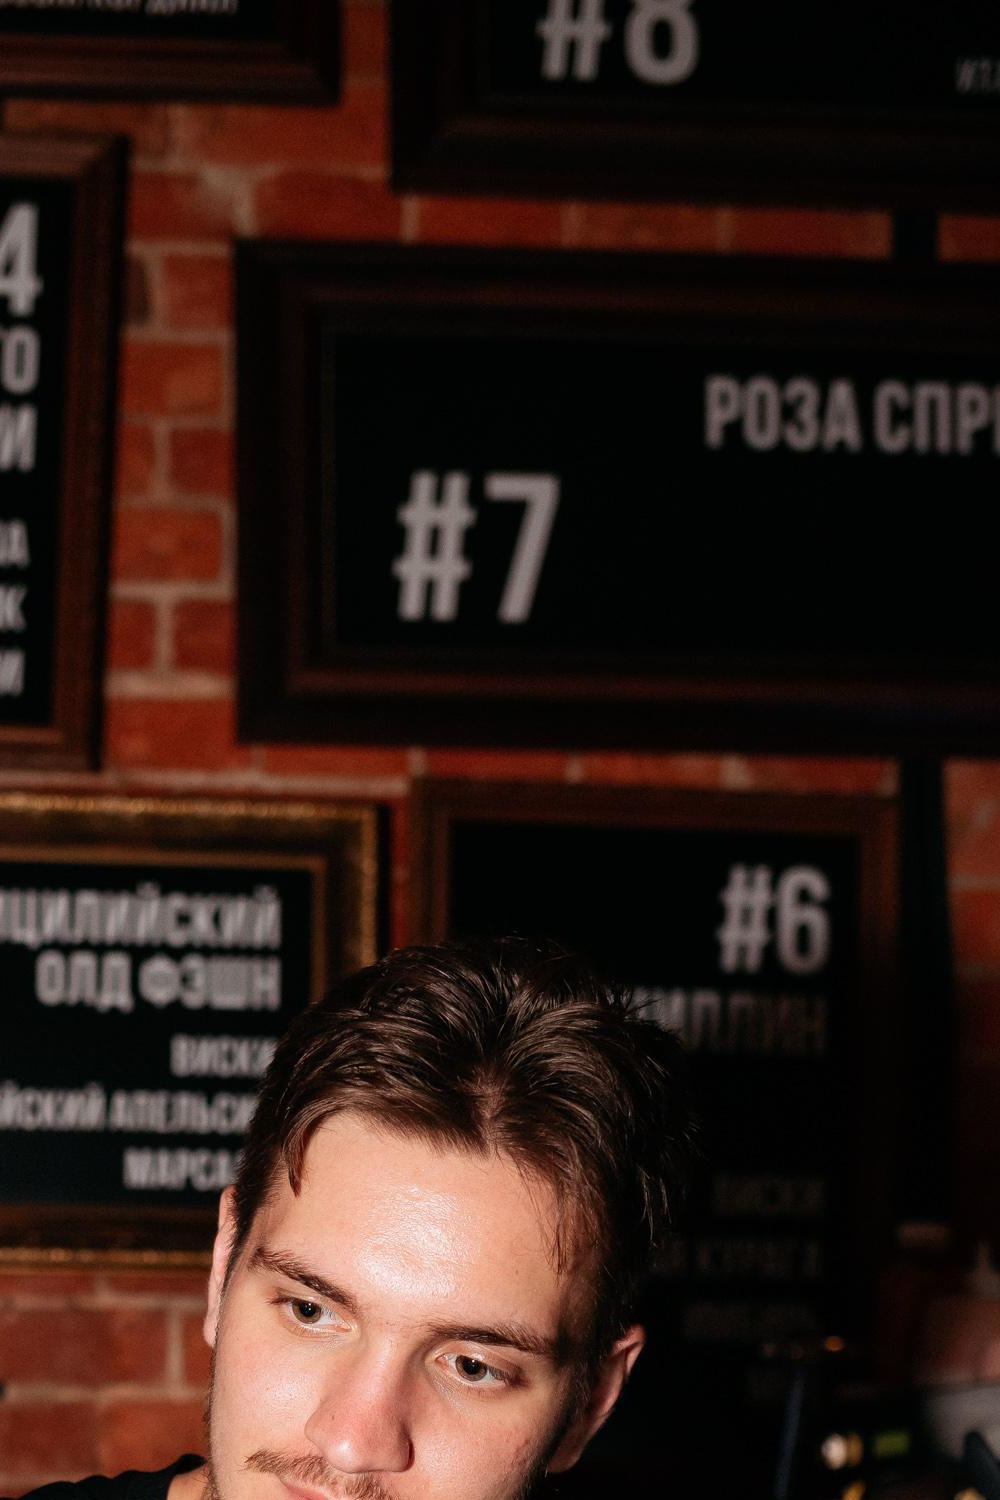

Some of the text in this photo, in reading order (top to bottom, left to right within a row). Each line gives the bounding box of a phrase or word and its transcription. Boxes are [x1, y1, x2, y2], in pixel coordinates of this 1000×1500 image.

[704, 374, 1000, 456] РОЗА СПР
[391, 469, 561, 624] #7
[716, 863, 832, 974] #6
[35, 951, 282, 1013] ОЛД ФЭШН
[109, 1090, 259, 1135] АПЕЛЬСИ
[122, 1147, 246, 1191] МАРСА
